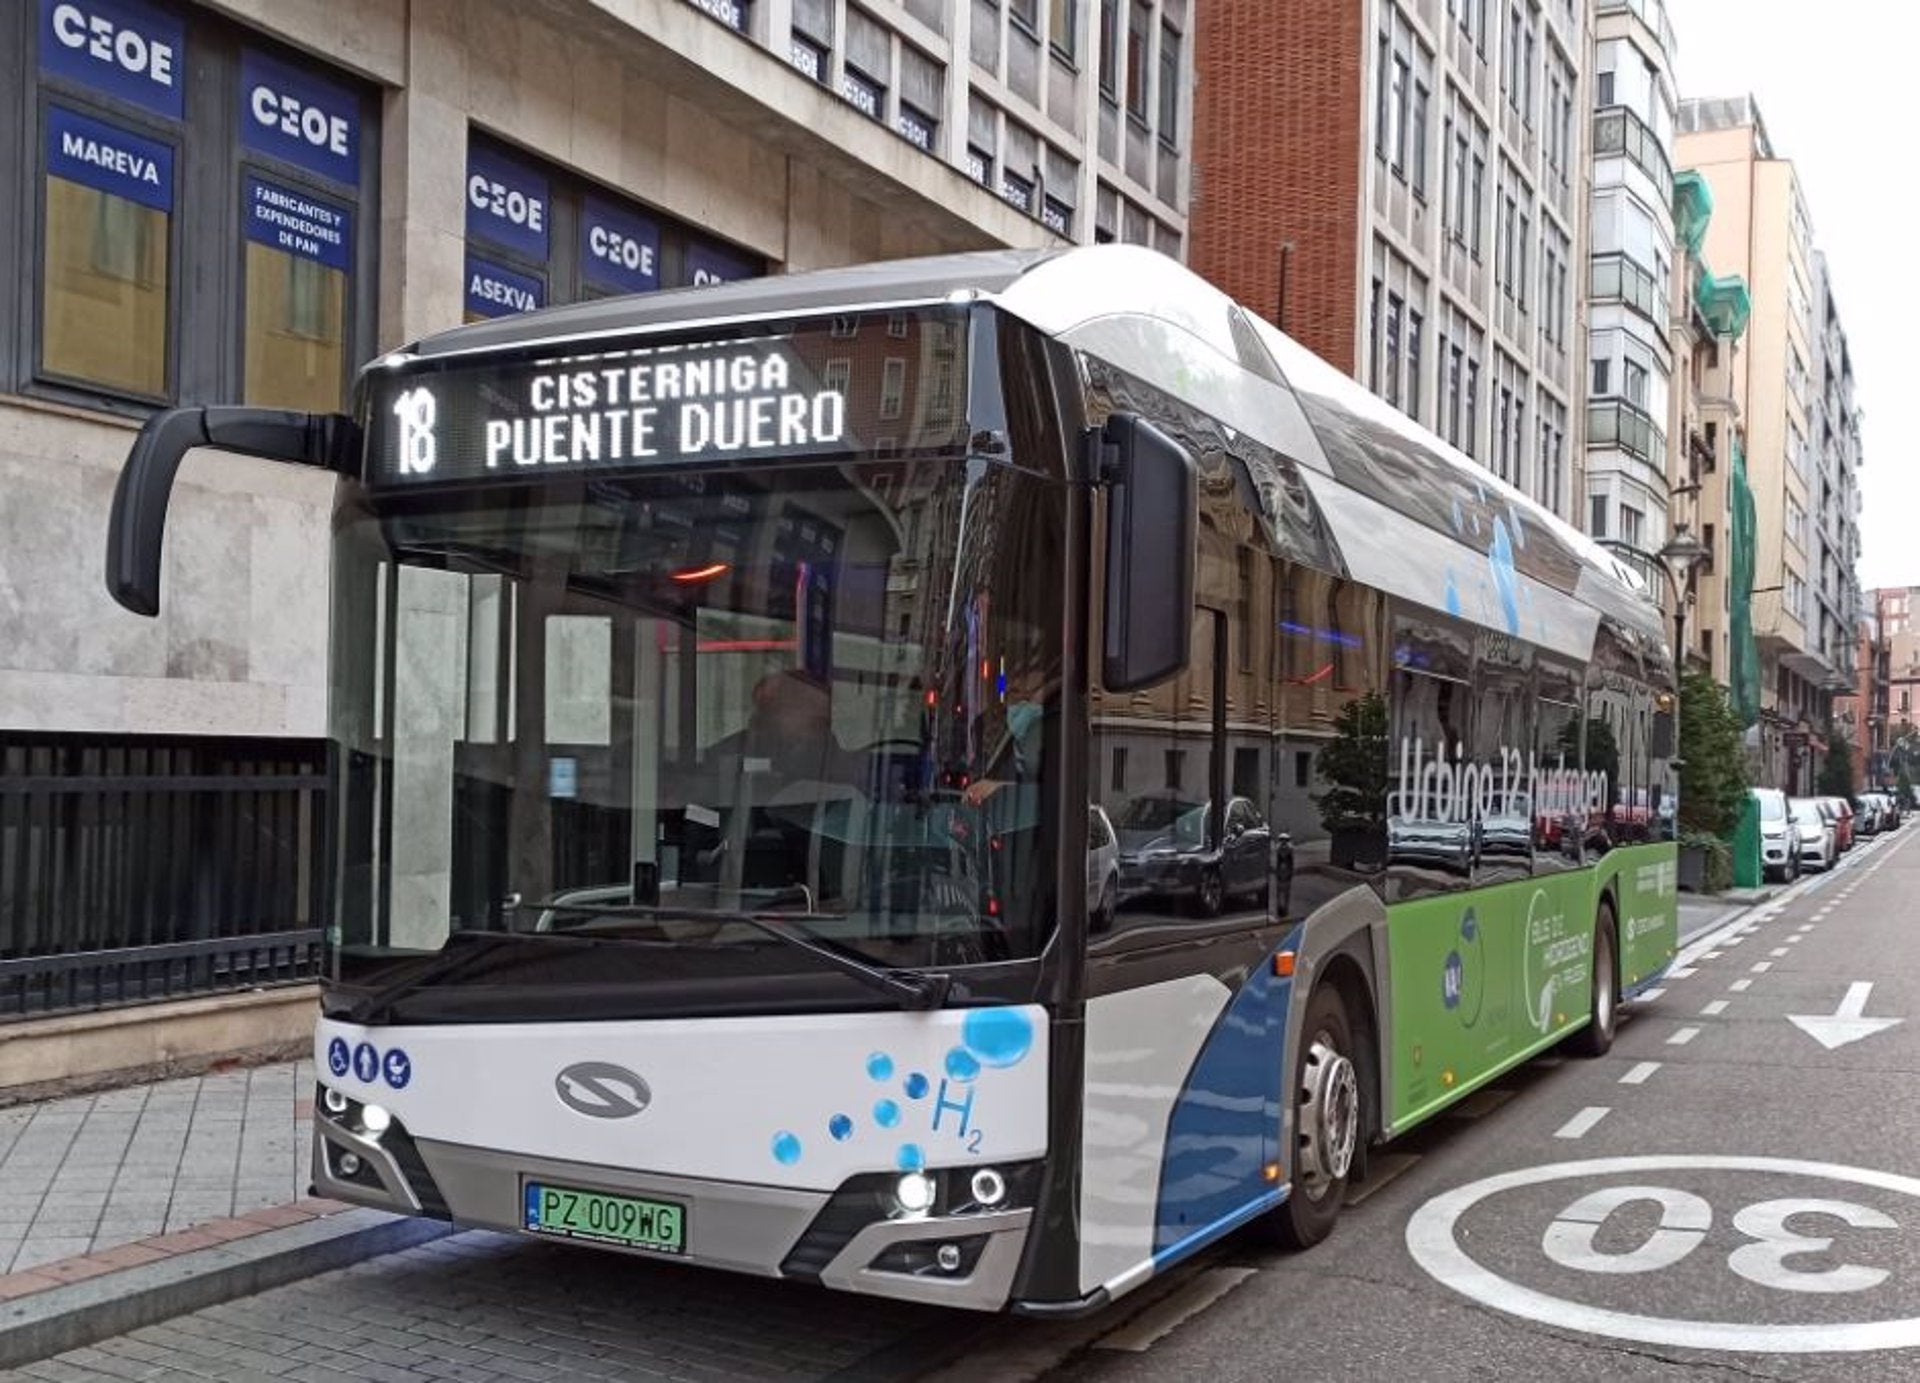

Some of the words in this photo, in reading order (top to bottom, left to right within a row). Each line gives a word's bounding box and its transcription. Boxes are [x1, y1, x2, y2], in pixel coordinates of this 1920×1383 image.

[53, 5, 173, 86] CEOE
[251, 86, 349, 156] CEOE
[62, 132, 159, 185] MAREVA
[256, 186, 332, 224] FABRICANTES
[332, 213, 342, 227] Y
[256, 205, 341, 245] EXPENDEDORES
[469, 174, 543, 232] CEOE
[279, 230, 295, 247] DE
[295, 236, 319, 255] PAN
[589, 226, 653, 276] CEOE
[471, 274, 536, 312] ASEXVA
[531, 353, 790, 411] CISTERNIGA
[393, 387, 436, 474] 18
[486, 408, 658, 468] PUENTE
[679, 389, 845, 454] DUERO
[1400, 736, 1494, 824] Urbino
[1501, 745, 1523, 816] 12
[1528, 749, 1608, 836] hydrogen
[545, 1191, 577, 1226] PZ
[589, 1198, 673, 1240] 009WG
